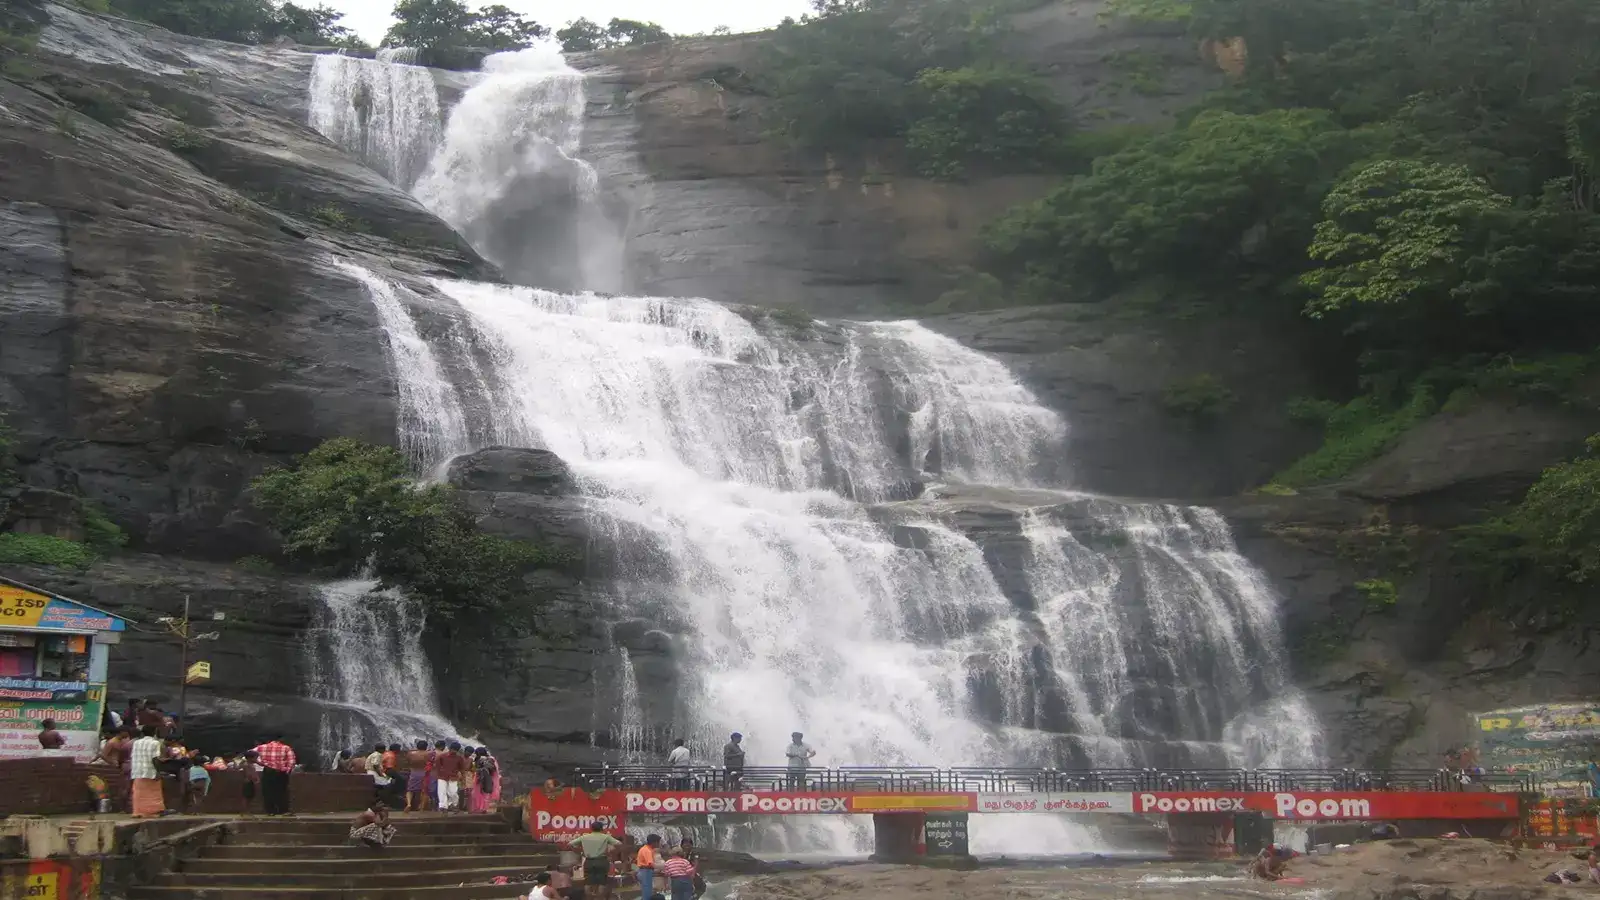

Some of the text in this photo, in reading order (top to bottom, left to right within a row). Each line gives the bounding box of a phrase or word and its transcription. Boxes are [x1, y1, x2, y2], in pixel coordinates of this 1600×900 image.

[15, 598, 46, 609] ISD
[626, 793, 848, 812] Poomex Poomex
[1140, 793, 1245, 812] Poomex
[1274, 793, 1370, 817] Poom
[536, 810, 618, 830] Poomex
